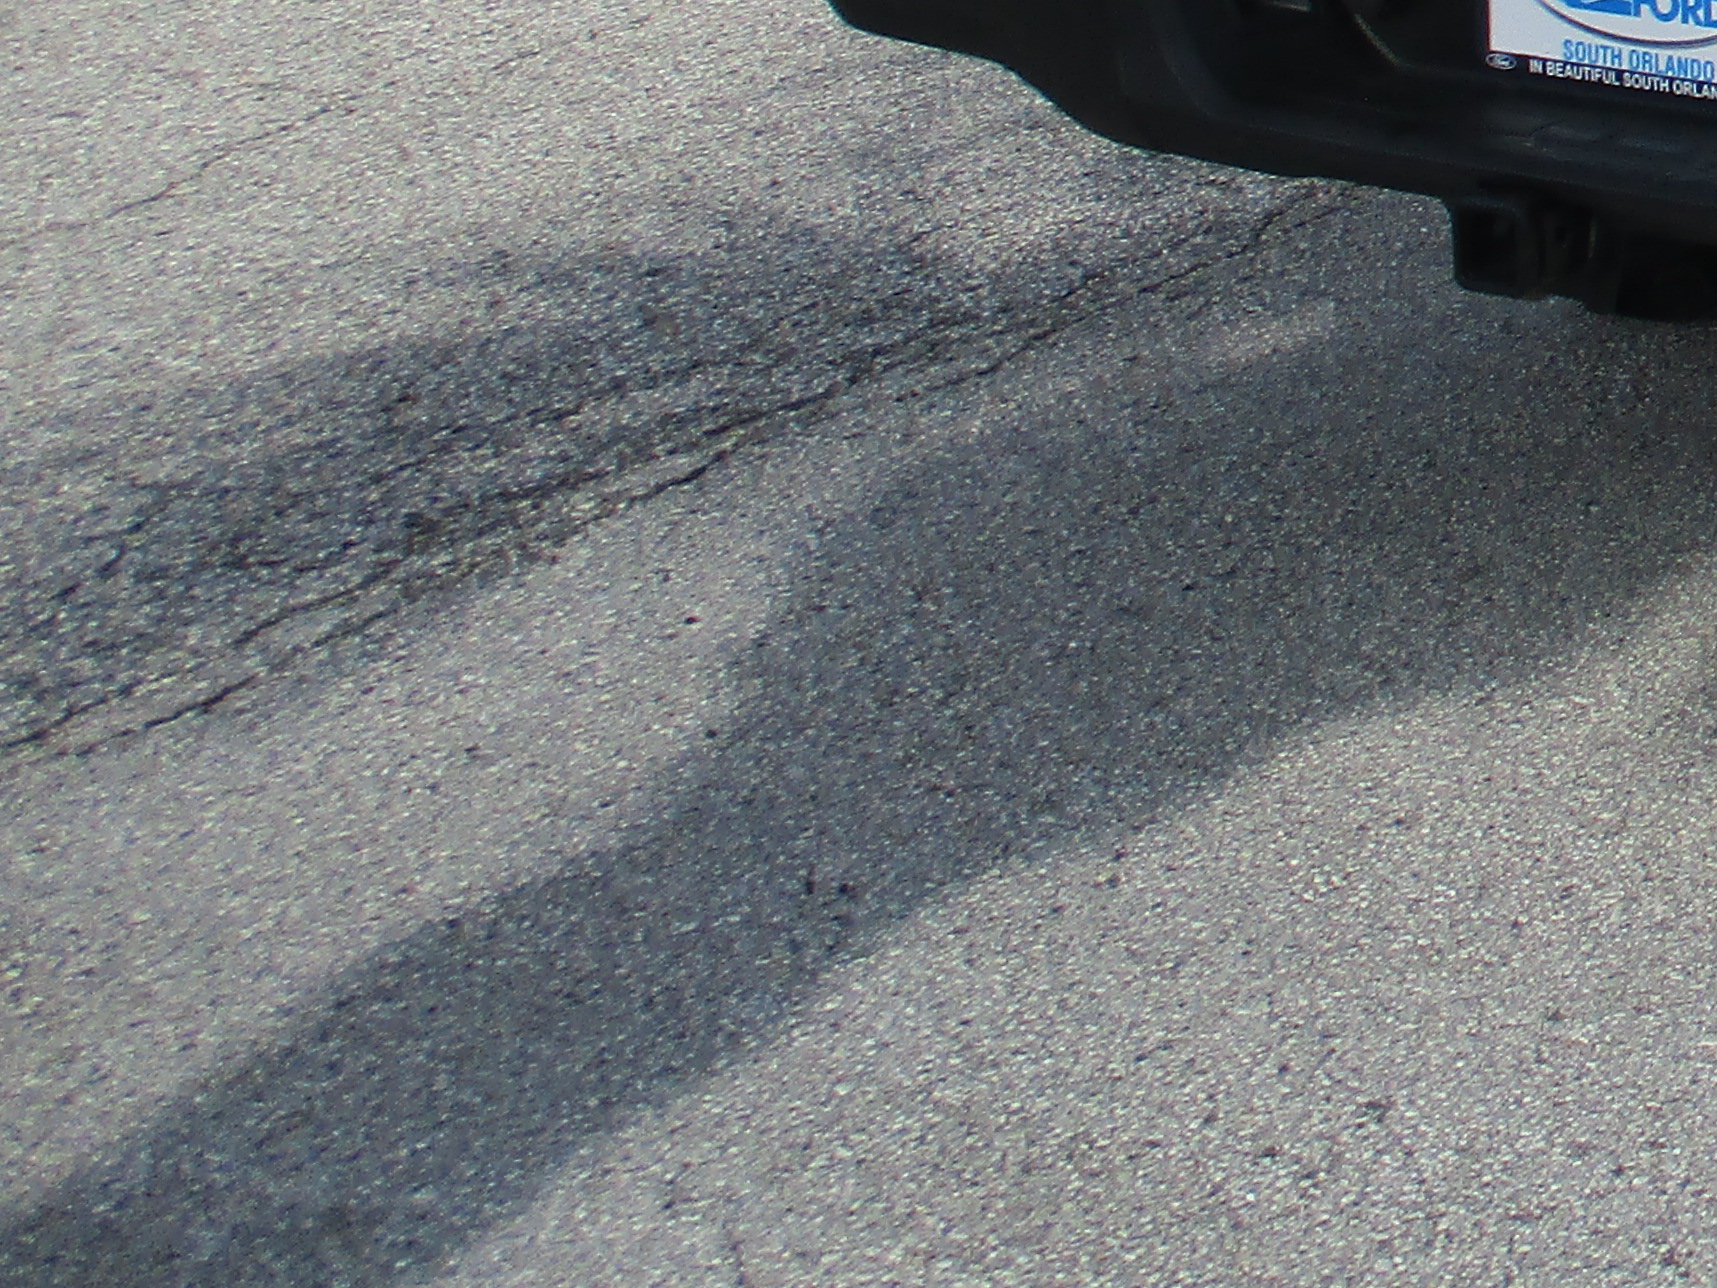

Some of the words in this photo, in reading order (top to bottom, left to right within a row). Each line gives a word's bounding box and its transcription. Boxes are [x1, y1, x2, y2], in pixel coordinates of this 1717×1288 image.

[1529, 58, 1544, 74] IN
[1546, 61, 1621, 87] BEAUTIFUL
[1622, 72, 1670, 94] SOUTH
[1562, 38, 1622, 68] SOUTH
[1627, 48, 1716, 82] ORLANDO
